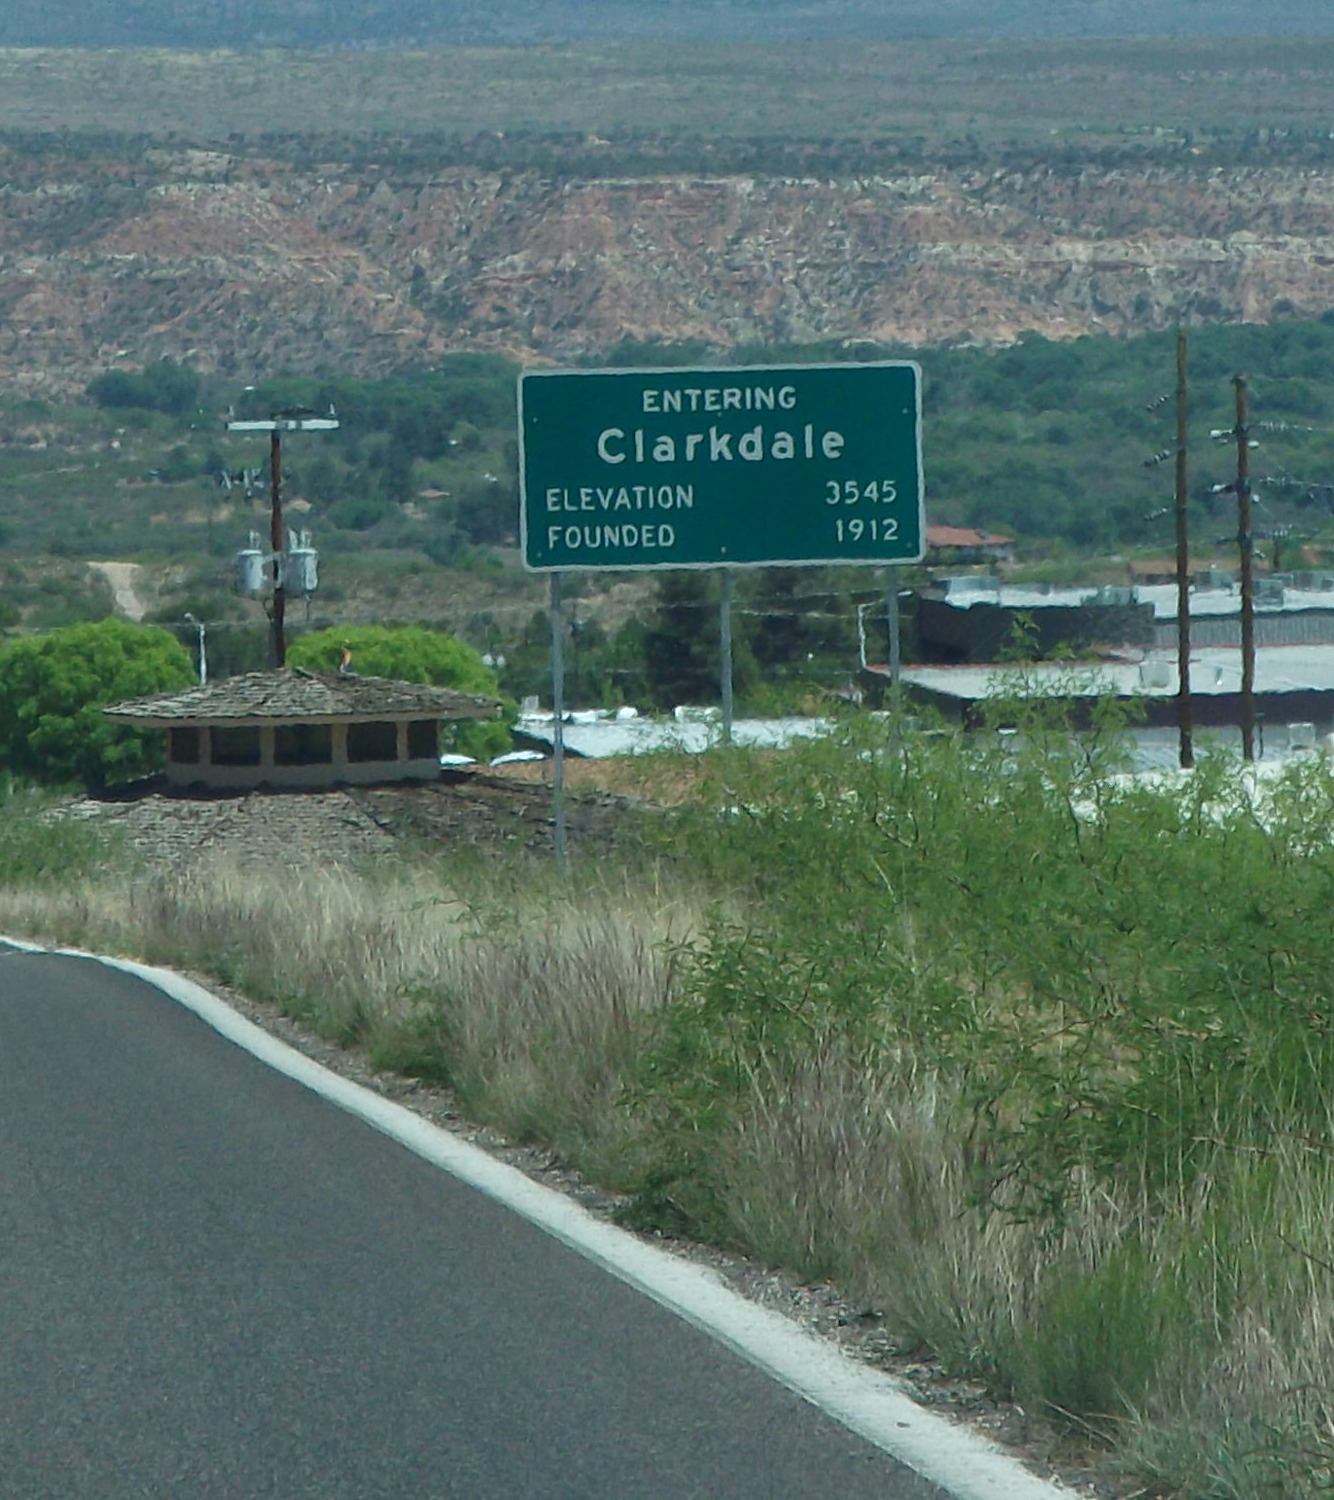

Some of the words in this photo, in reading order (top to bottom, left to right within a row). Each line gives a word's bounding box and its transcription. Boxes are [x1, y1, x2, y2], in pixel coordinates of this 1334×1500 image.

[643, 386, 797, 413] ENTERING
[597, 424, 845, 464] Clarkdale
[546, 485, 694, 512] ELEVATION
[825, 480, 898, 505] 3545
[548, 524, 675, 549] FOUNDED
[835, 518, 899, 543] 1912
